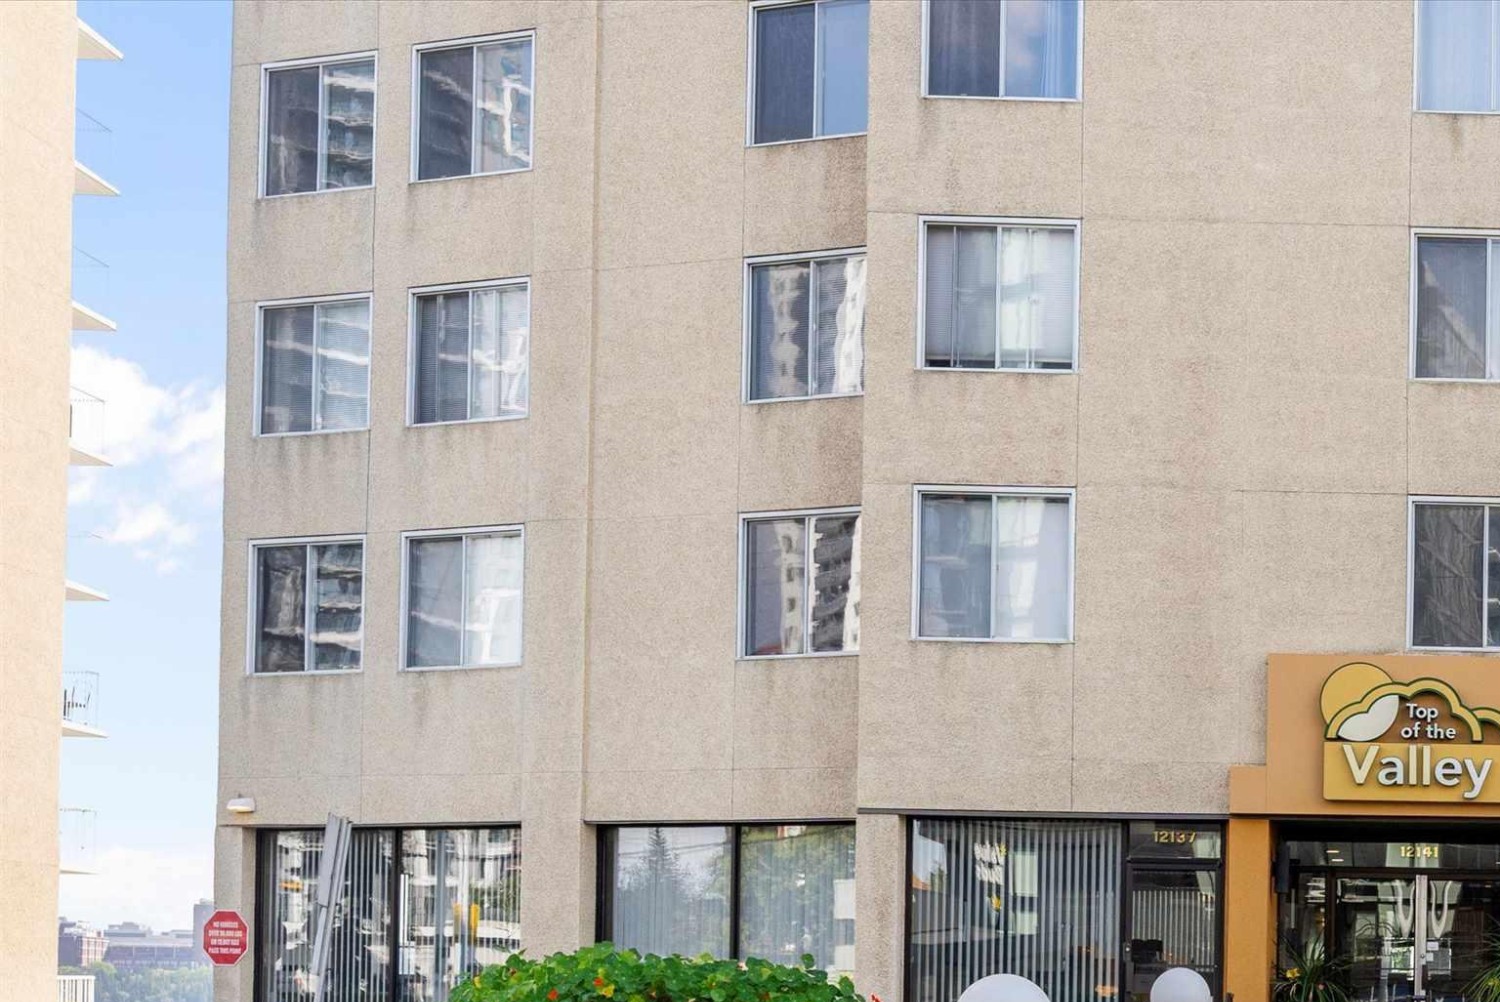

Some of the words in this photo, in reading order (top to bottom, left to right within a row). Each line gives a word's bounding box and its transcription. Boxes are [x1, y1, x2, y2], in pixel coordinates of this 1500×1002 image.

[1406, 703, 1439, 723] Top
[1401, 722, 1421, 739] of
[1425, 723, 1456, 740] the
[1342, 744, 1493, 799] Valley
[1153, 831, 1196, 843] 12137
[1400, 846, 1439, 858] 12141
